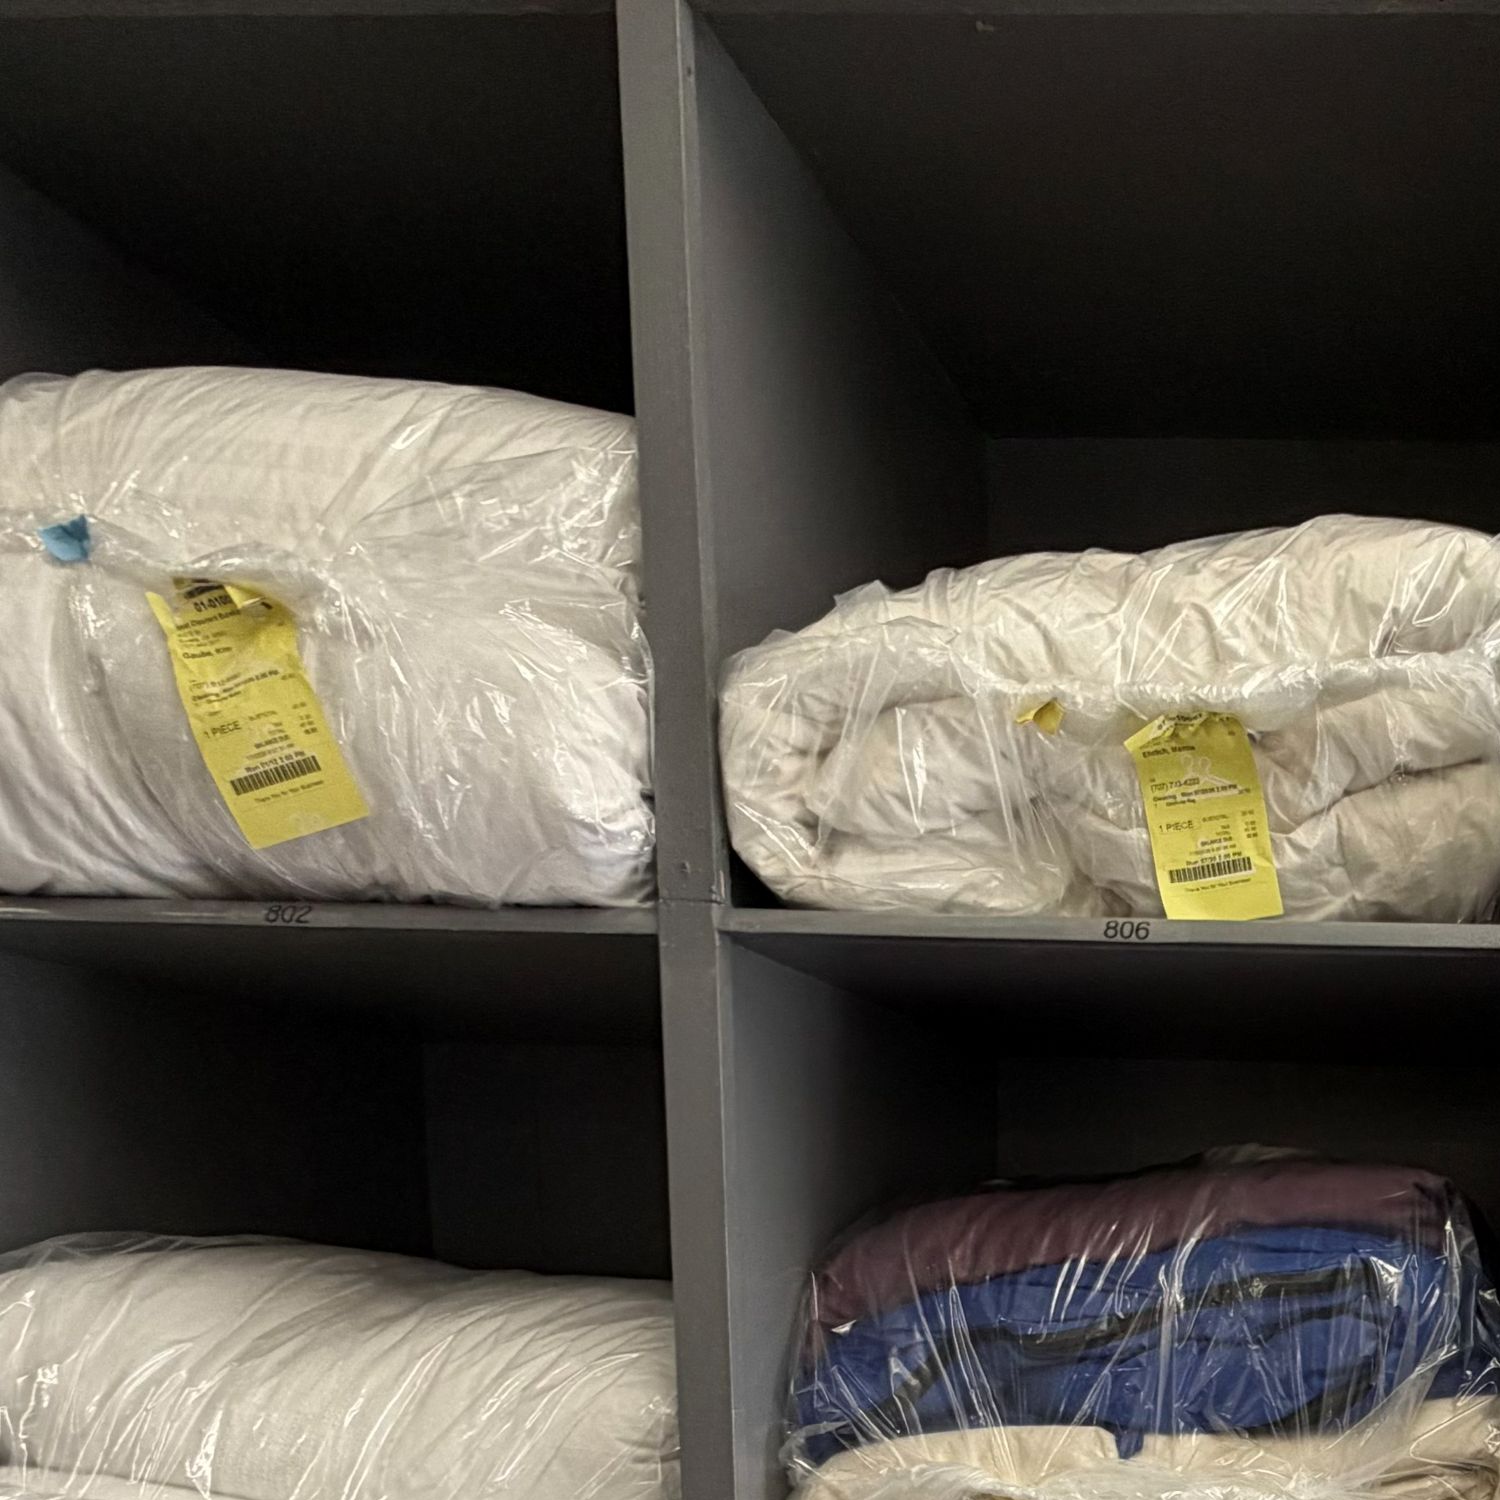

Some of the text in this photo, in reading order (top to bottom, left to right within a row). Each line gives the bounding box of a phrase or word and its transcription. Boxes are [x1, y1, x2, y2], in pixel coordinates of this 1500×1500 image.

[211, 720, 242, 736] PIECE
[1166, 820, 1195, 831] PIECE
[265, 905, 312, 923] 802
[1104, 920, 1150, 939] 806
